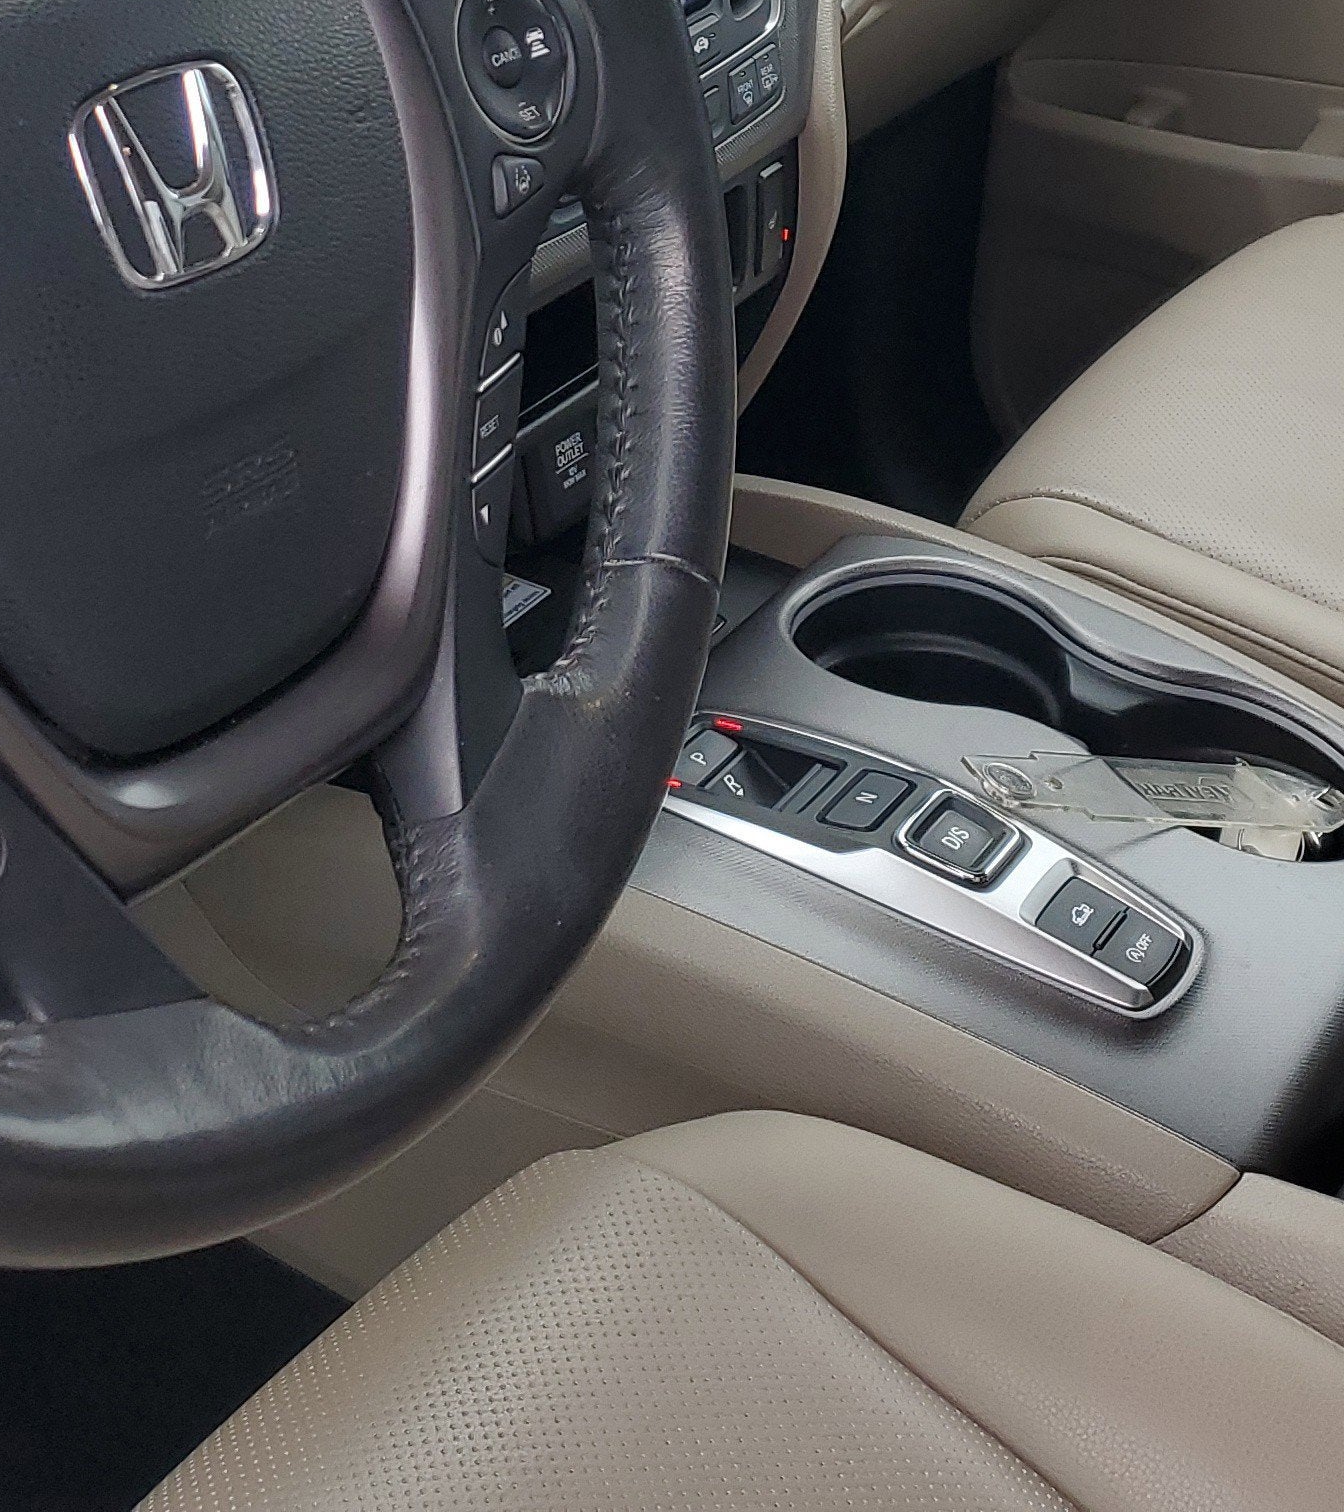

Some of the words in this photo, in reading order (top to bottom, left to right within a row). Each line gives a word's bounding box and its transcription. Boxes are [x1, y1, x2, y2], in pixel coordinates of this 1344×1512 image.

[519, 105, 542, 122] SET
[555, 431, 583, 456] POWER
[557, 441, 584, 468] OUTLET
[689, 751, 707, 766] P
[722, 773, 740, 794] R
[855, 791, 878, 804] N
[941, 826, 970, 850] D/S
[1136, 933, 1153, 951] OFF
